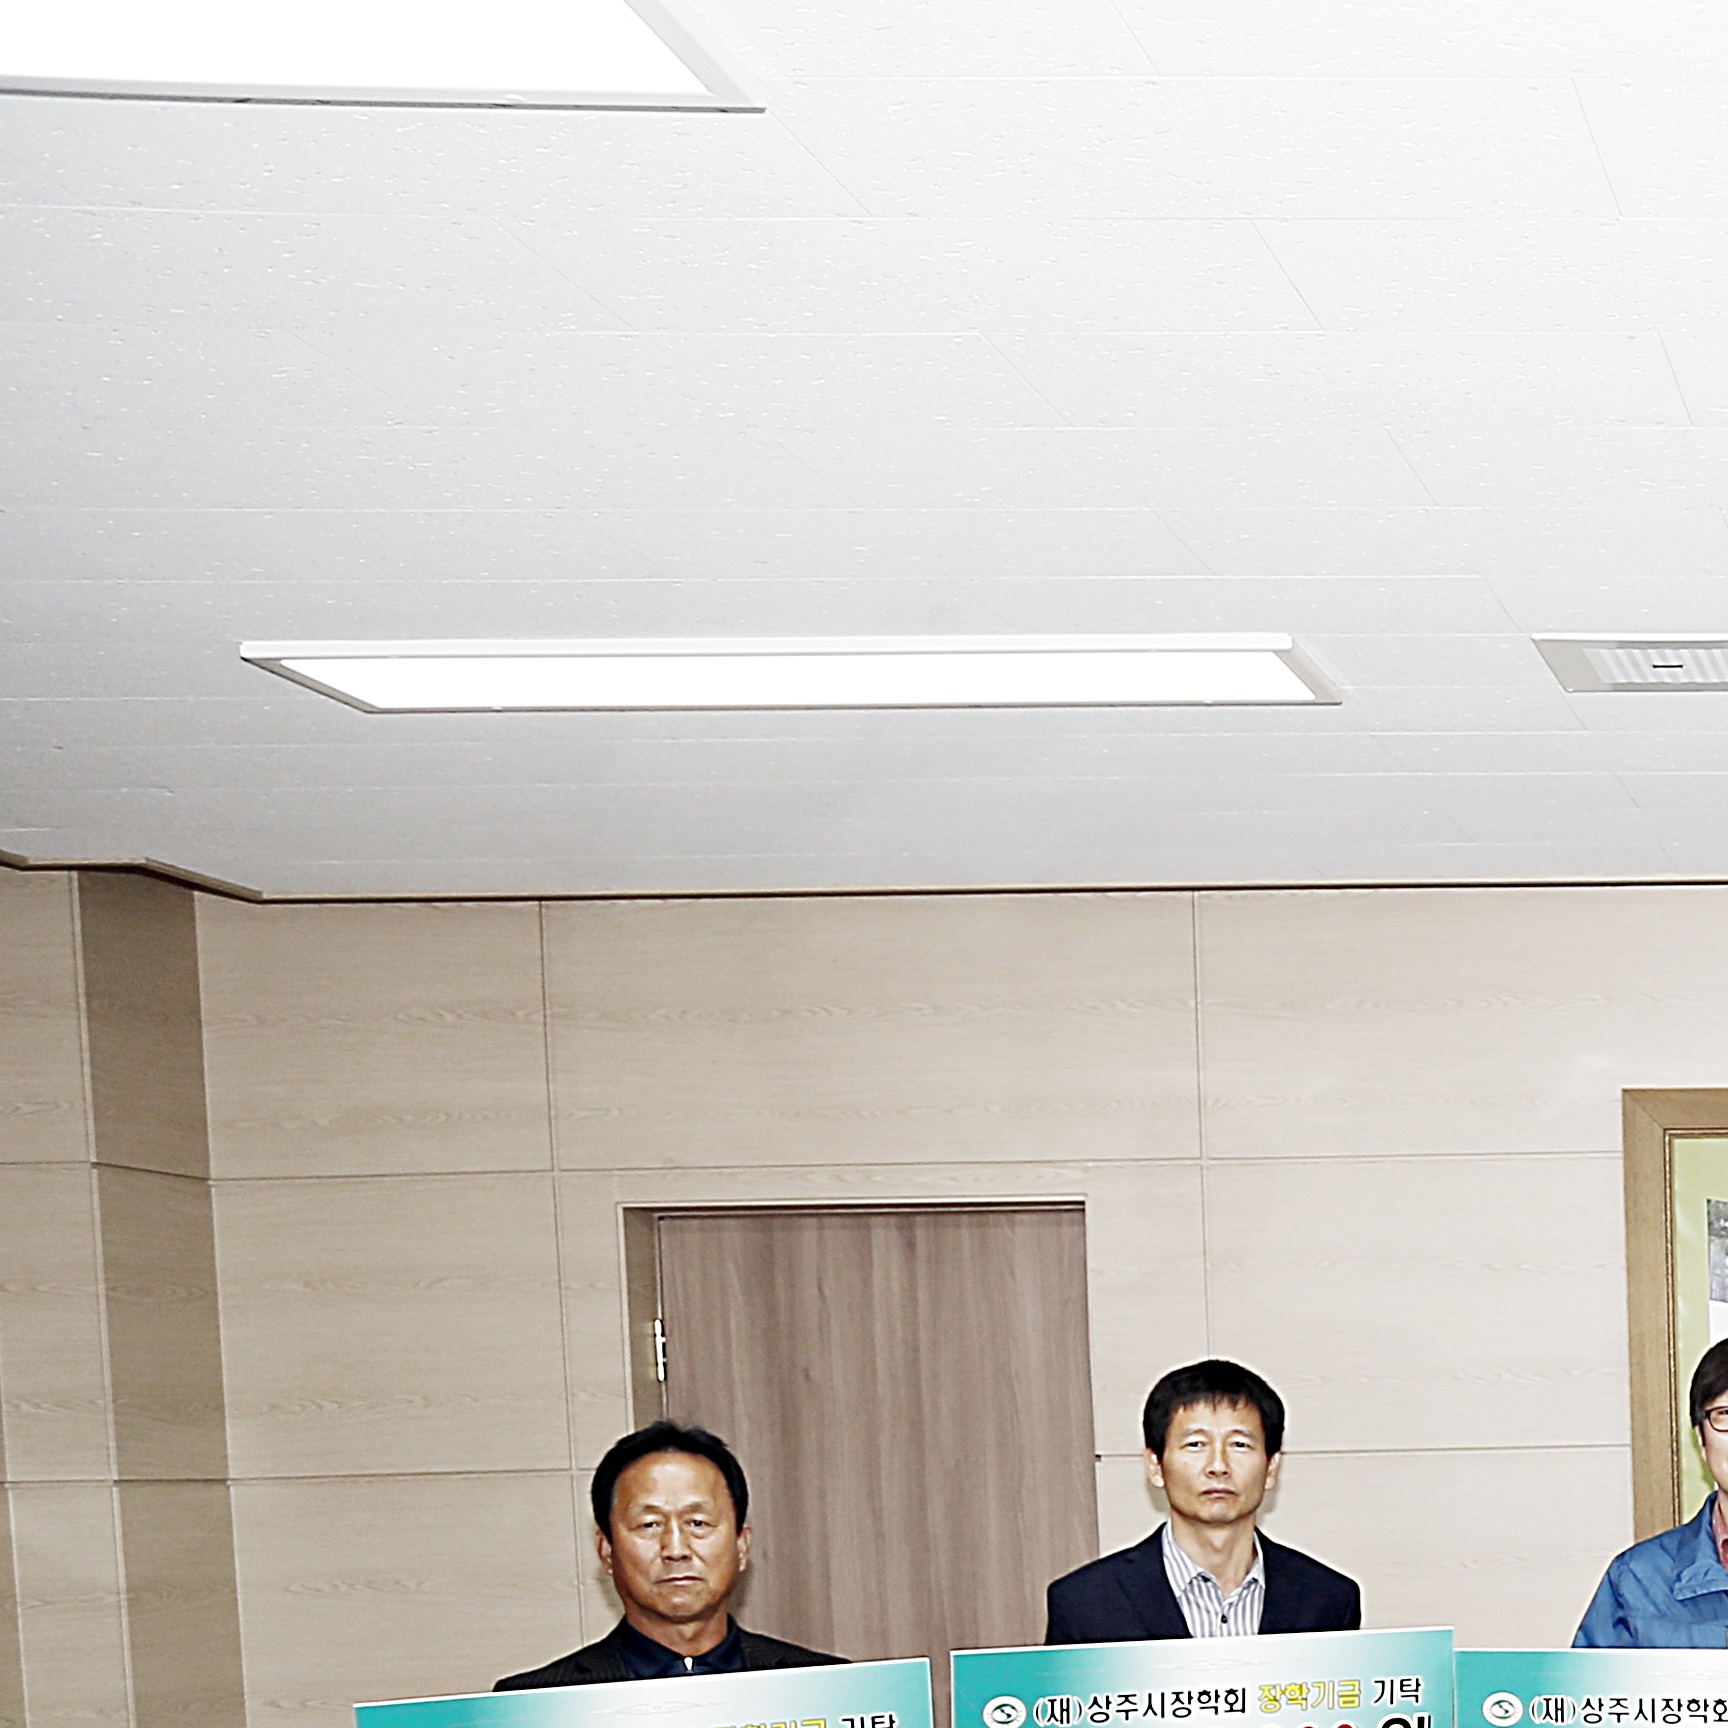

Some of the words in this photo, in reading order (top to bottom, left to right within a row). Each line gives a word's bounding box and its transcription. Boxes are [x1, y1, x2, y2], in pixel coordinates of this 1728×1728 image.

[1033, 1688, 1247, 1725] (재)상주시장학회
[1257, 1680, 1361, 1713] 장학기금
[1373, 1678, 1422, 1705] 기탁
